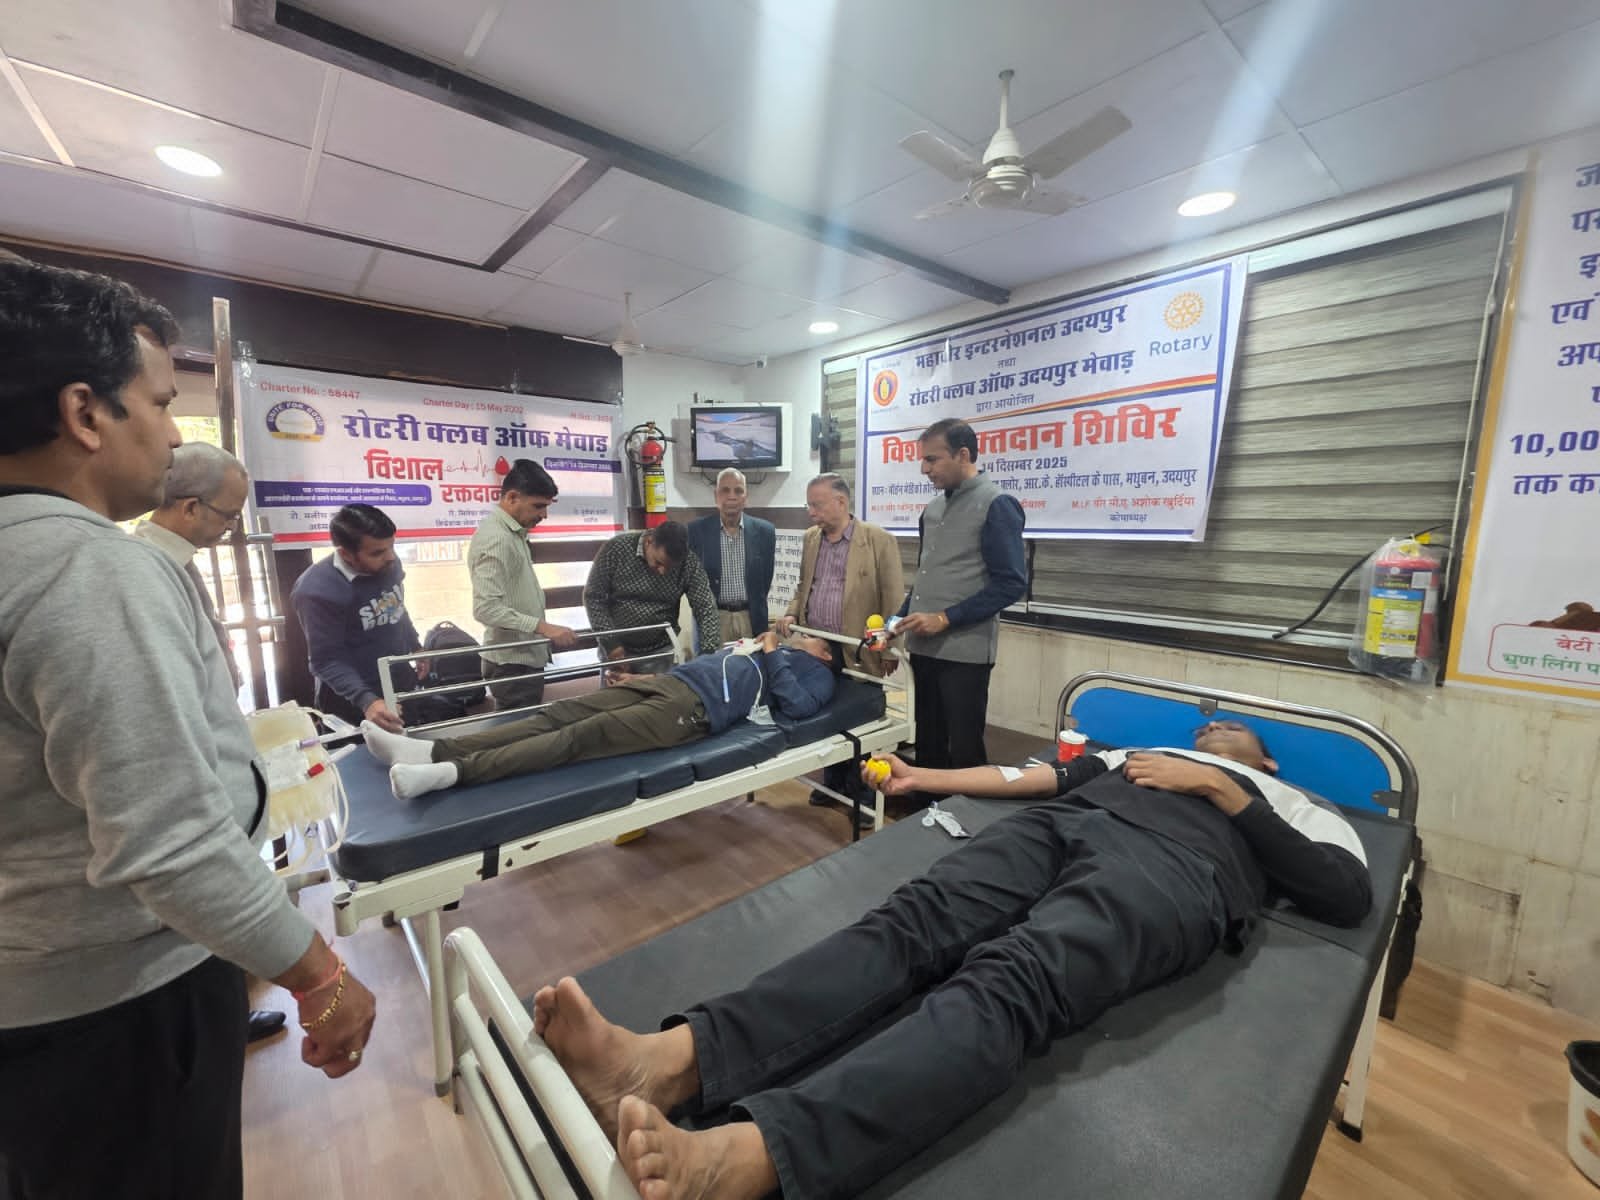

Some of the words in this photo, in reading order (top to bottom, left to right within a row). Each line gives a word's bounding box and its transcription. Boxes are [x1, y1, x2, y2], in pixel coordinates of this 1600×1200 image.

[1061, 304, 1128, 337] उदयपुर
[1149, 334, 1213, 357] Rotary
[260, 381, 300, 394] Charter
[909, 384, 941, 407] रोटरी
[943, 381, 976, 401] क्लब
[979, 372, 1016, 394] ऑफ
[1019, 360, 1078, 387] उदयपुर
[1082, 350, 1136, 375] मेवाड़
[286, 401, 304, 409] FOR
[423, 399, 453, 408] Charter
[995, 393, 1034, 409] आयोजित
[341, 409, 421, 441] रोटरी
[425, 422, 489, 446] क्लब
[495, 422, 551, 448] ऑफ
[554, 426, 609, 458] मेवाड़
[1073, 403, 1182, 446] शिविर
[364, 448, 444, 480] विशाल
[996, 458, 1032, 472] दिसम्बर
[1035, 456, 1067, 469] 2025
[1092, 471, 1101, 487] के
[1162, 469, 1197, 487] उदयपुर
[1513, 474, 1564, 495] तक
[1555, 634, 1594, 652] बेटी
[1541, 654, 1582, 672] लिंग
